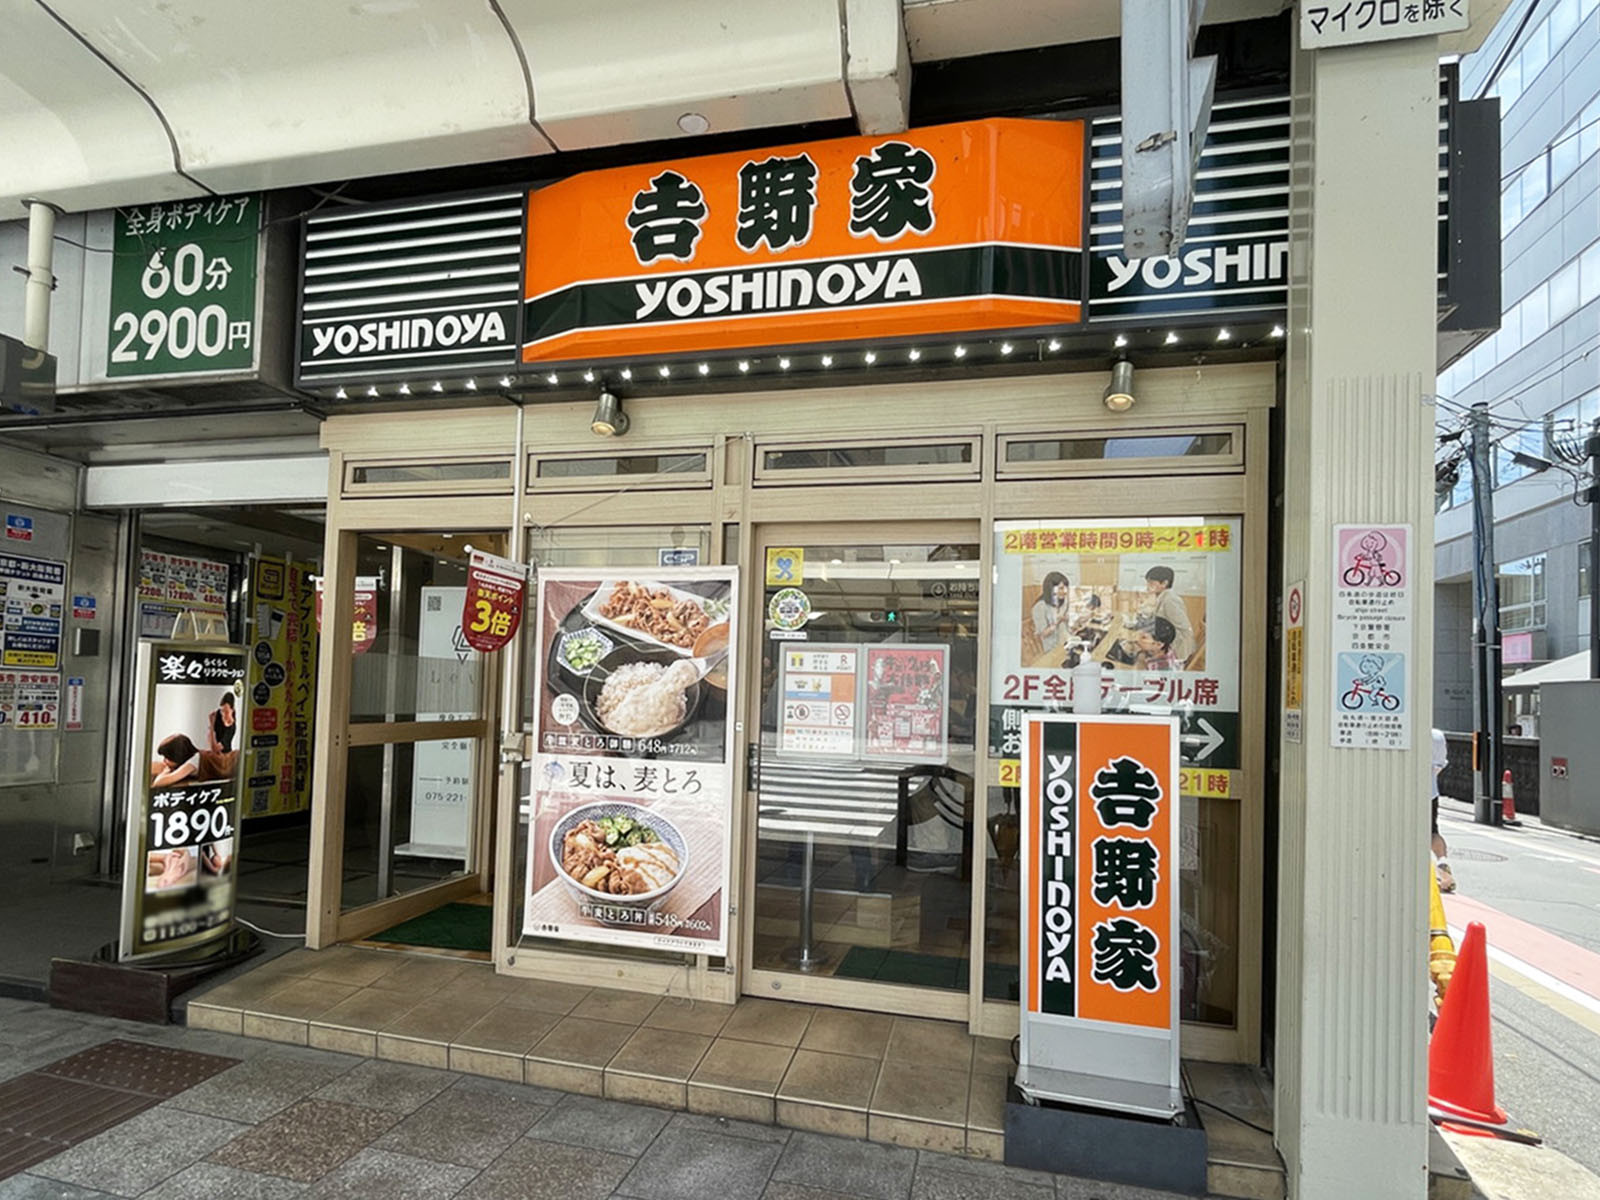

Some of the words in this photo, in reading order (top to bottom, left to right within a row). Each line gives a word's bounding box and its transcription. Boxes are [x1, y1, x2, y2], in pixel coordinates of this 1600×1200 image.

[141, 243, 233, 299] 60分
[634, 258, 922, 320] YOSHINOYA
[111, 304, 251, 362] 2900円
[312, 311, 506, 357] YOSHINOYA
[470, 600, 512, 636] 3倍
[1003, 675, 1220, 706] 2F全テーブル席
[153, 788, 222, 808] ボディケア
[569, 761, 702, 794] 夏は、麦とろ
[1045, 754, 1073, 983] YOSHINOYA
